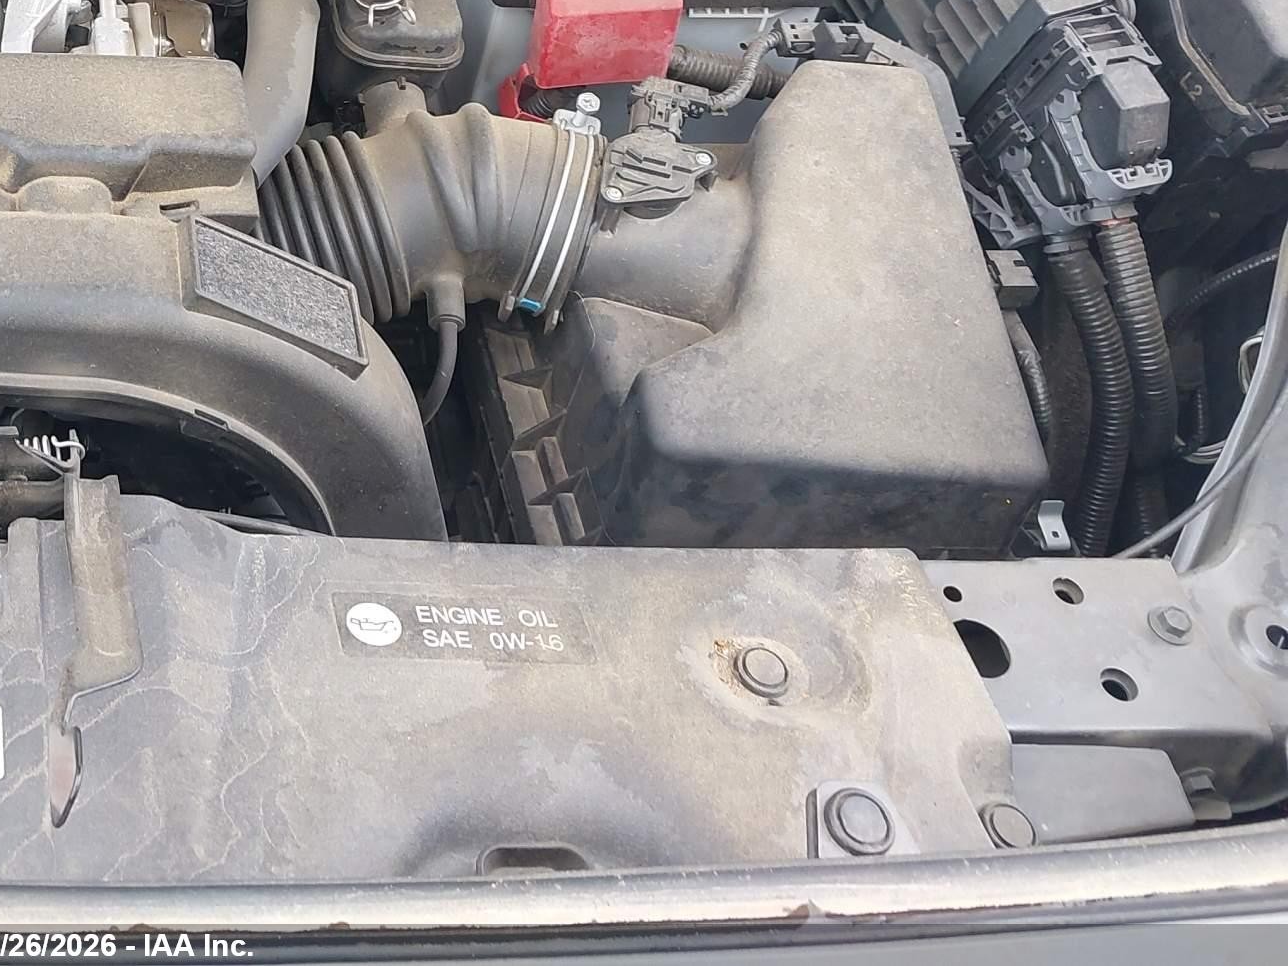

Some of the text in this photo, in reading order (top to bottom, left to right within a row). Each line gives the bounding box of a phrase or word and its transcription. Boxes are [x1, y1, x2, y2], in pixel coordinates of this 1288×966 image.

[415, 605, 559, 628] ENGINE OIL
[422, 629, 564, 652] SAE 0W-16
